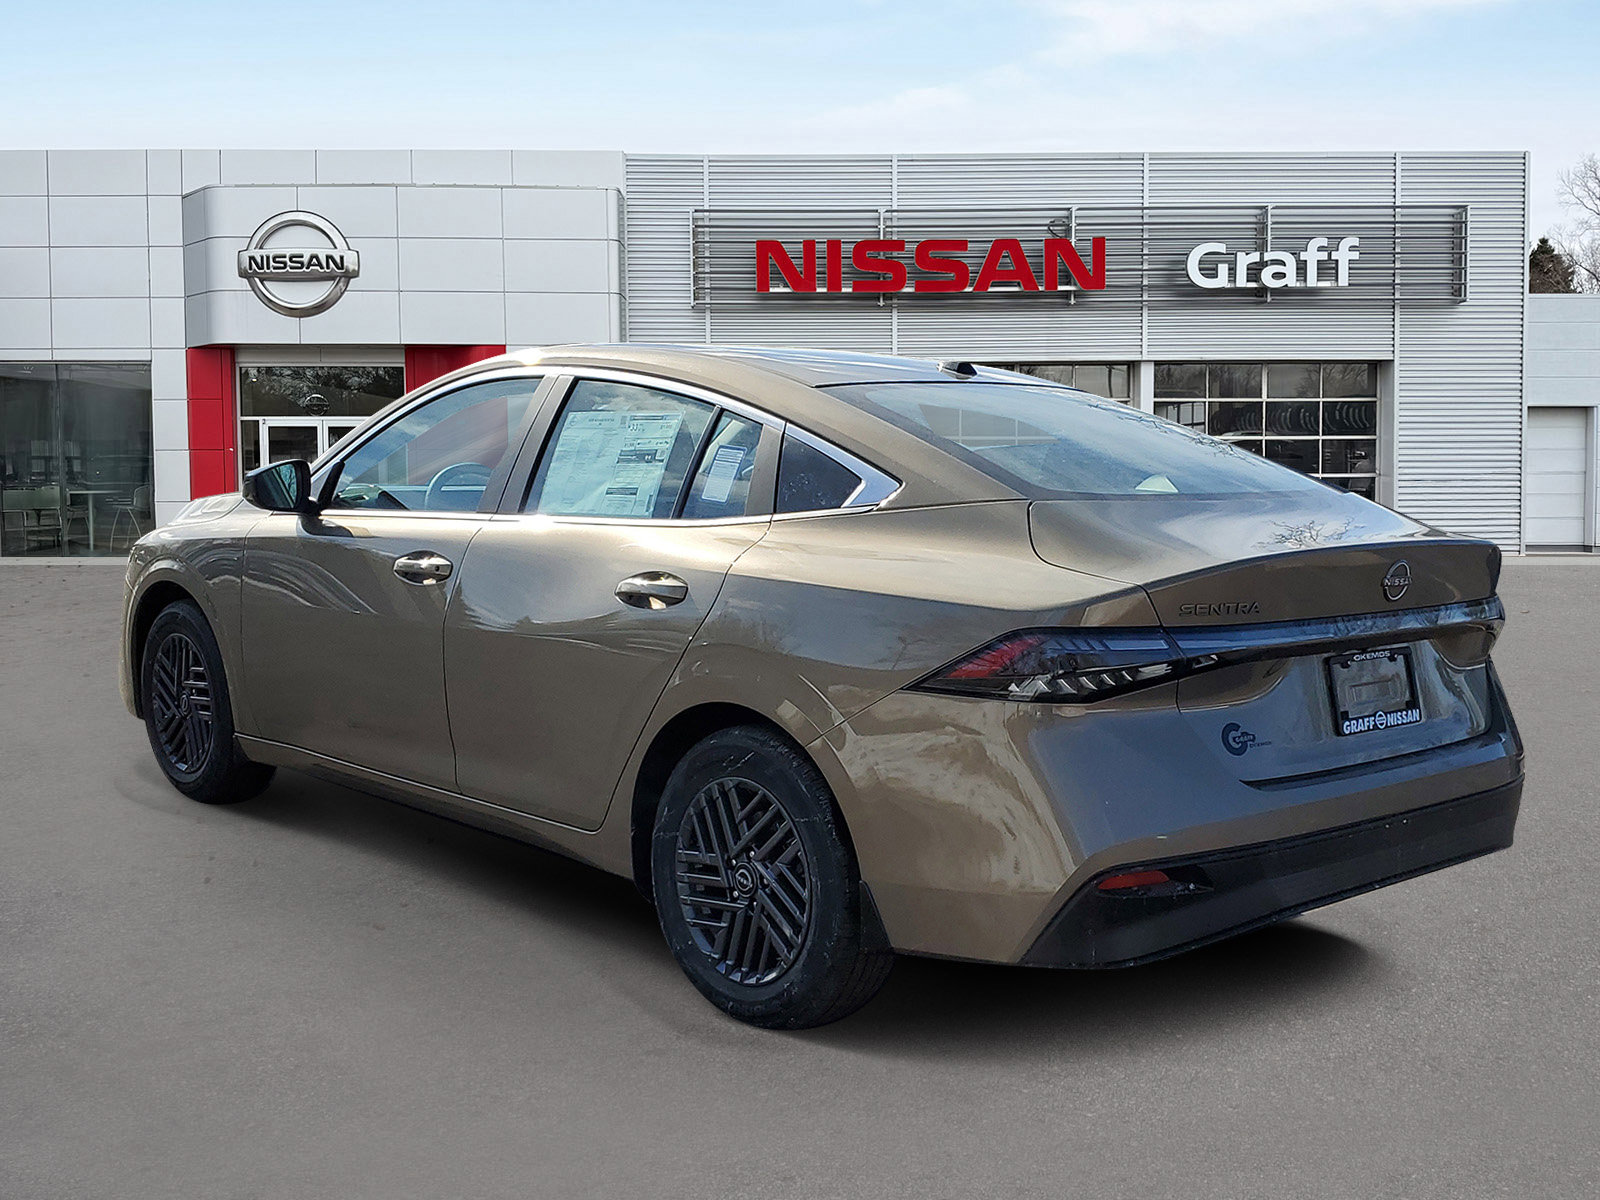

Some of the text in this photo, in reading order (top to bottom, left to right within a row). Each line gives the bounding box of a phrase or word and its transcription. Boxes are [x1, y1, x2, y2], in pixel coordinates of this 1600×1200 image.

[247, 253, 345, 272] NISSAN
[755, 237, 1106, 292] NISSAN
[1187, 237, 1360, 288] Graff
[1179, 601, 1260, 616] SENTRA
[1353, 650, 1391, 661] OKEMOS
[1343, 708, 1420, 734] GRAFF NISSAN
